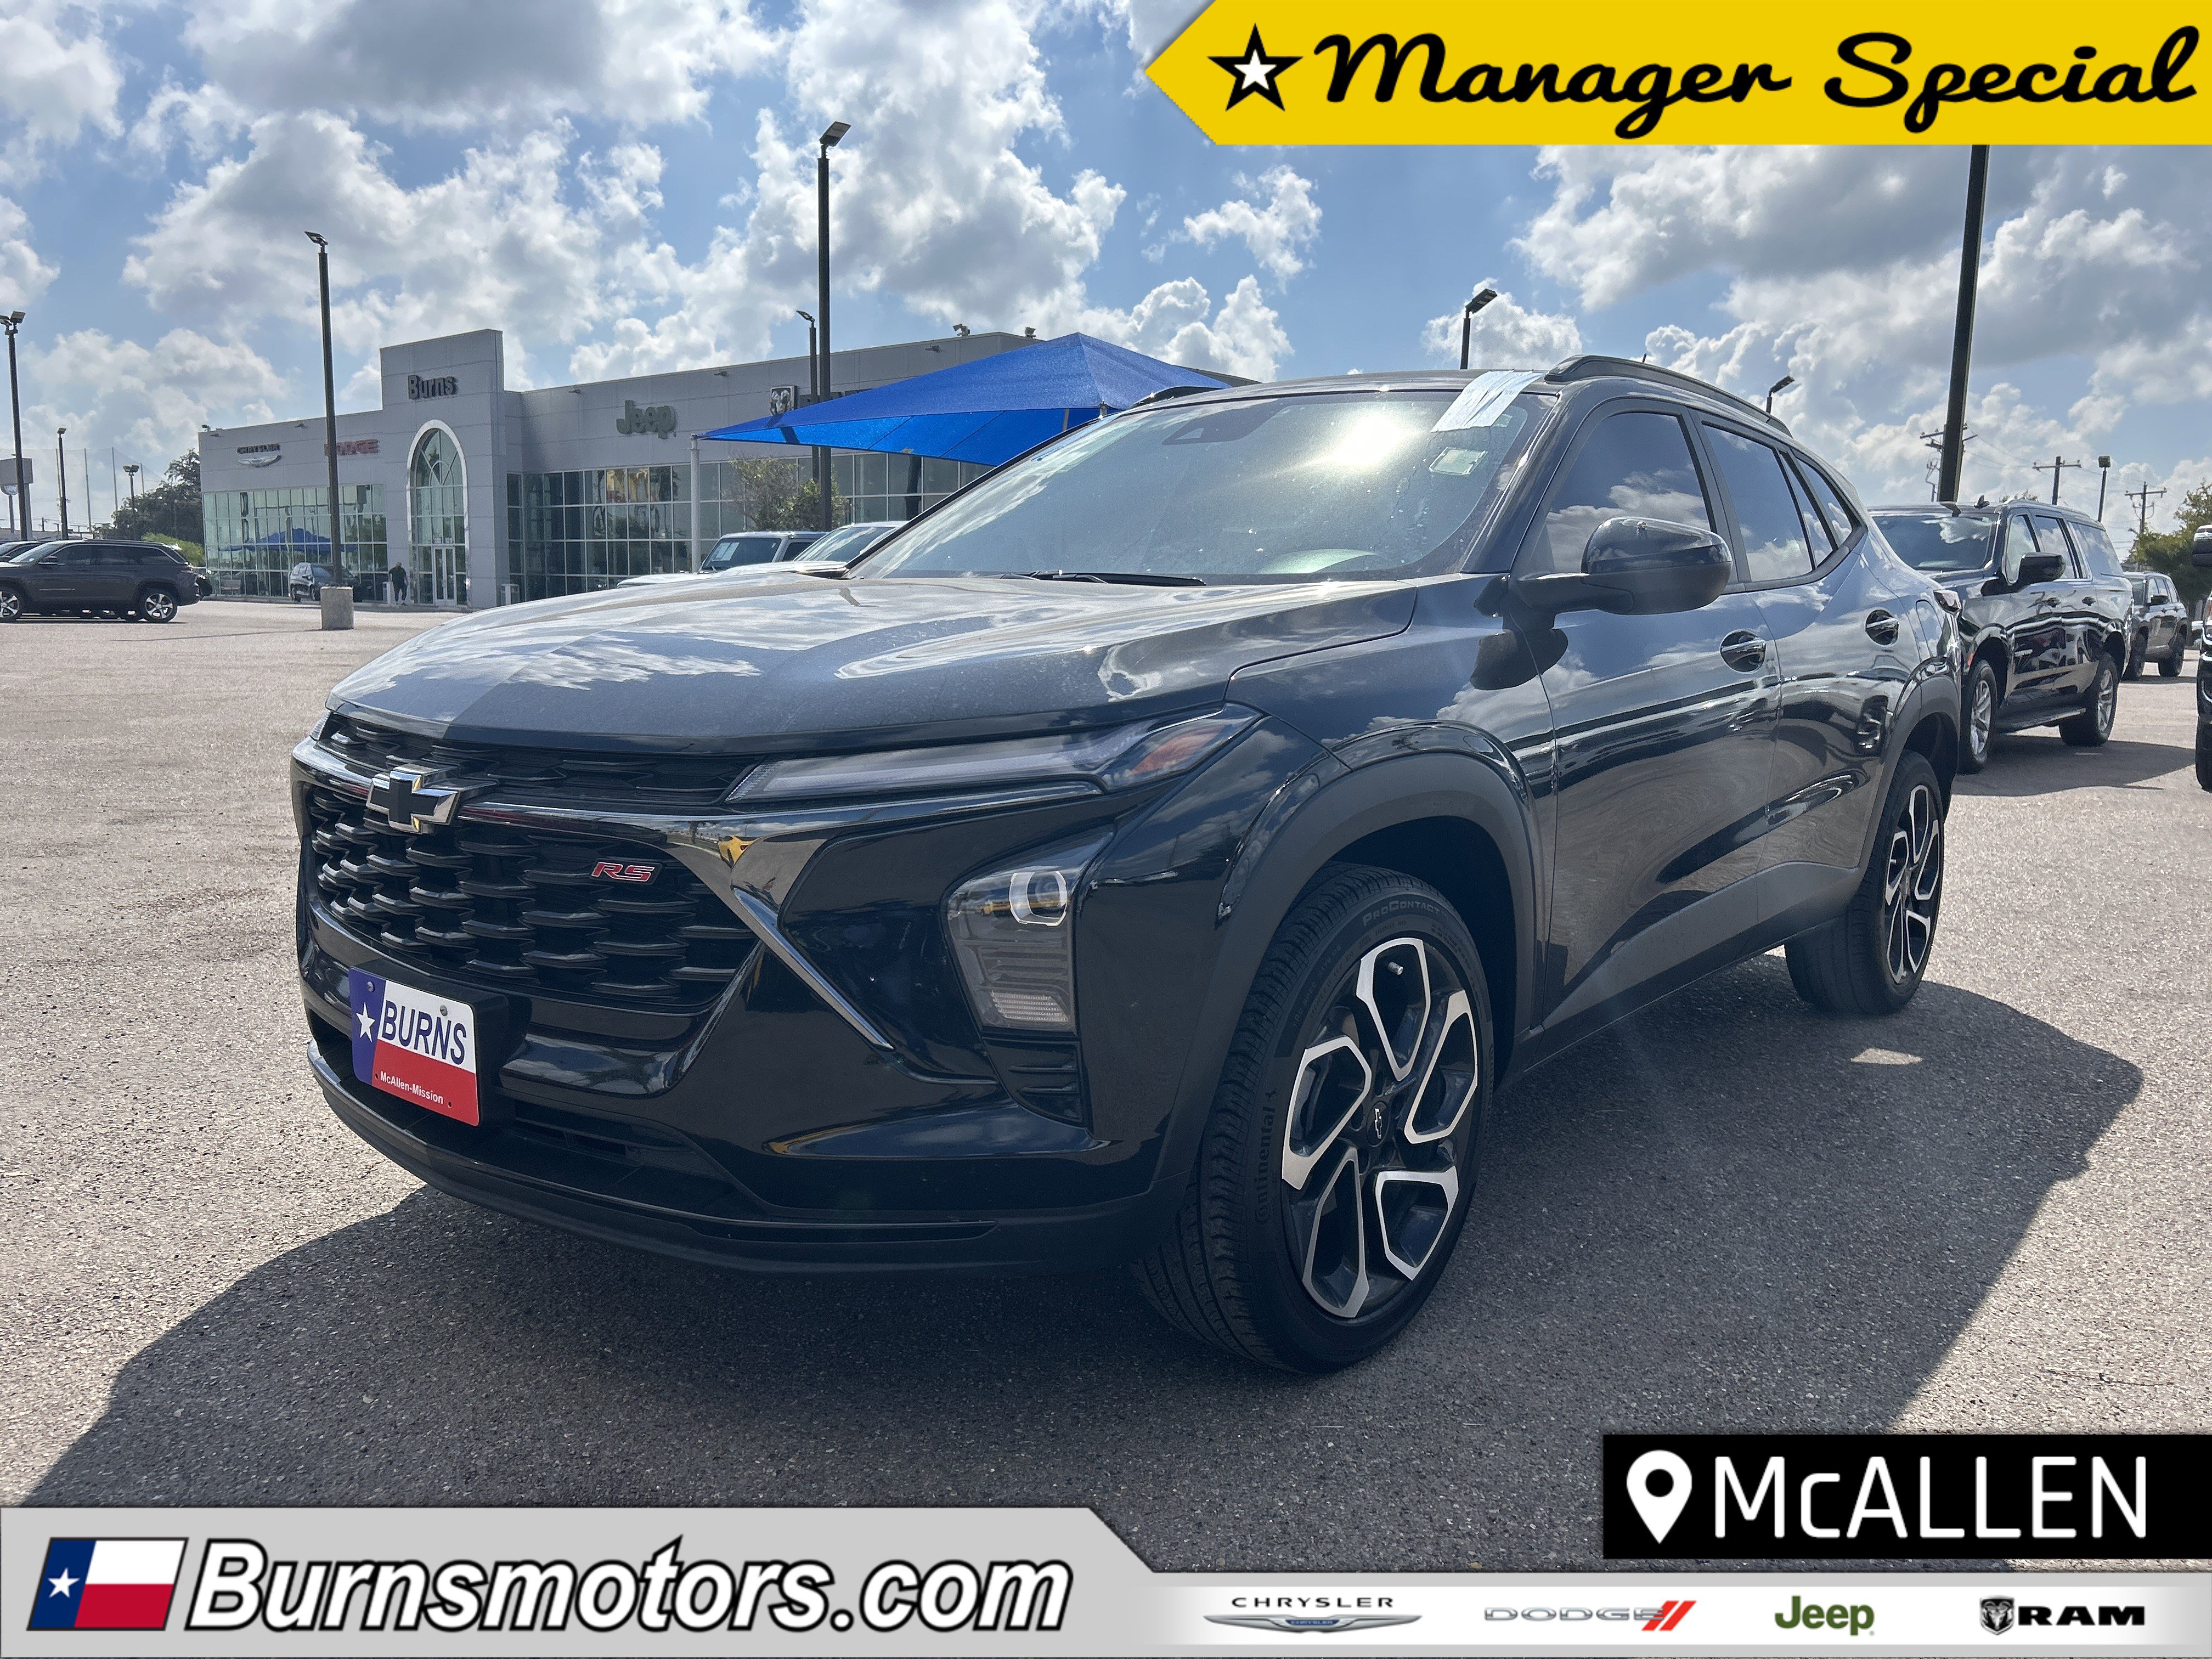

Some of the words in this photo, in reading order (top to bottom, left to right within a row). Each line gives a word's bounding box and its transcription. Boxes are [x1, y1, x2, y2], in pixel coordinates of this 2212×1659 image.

[408, 375, 458, 399] Burns
[616, 400, 676, 439] Jeep
[591, 861, 655, 882] RS
[381, 1000, 467, 1065] BURNS
[380, 1070, 444, 1104] McAllen-Mission
[1254, 1106, 1276, 1225] Continental
